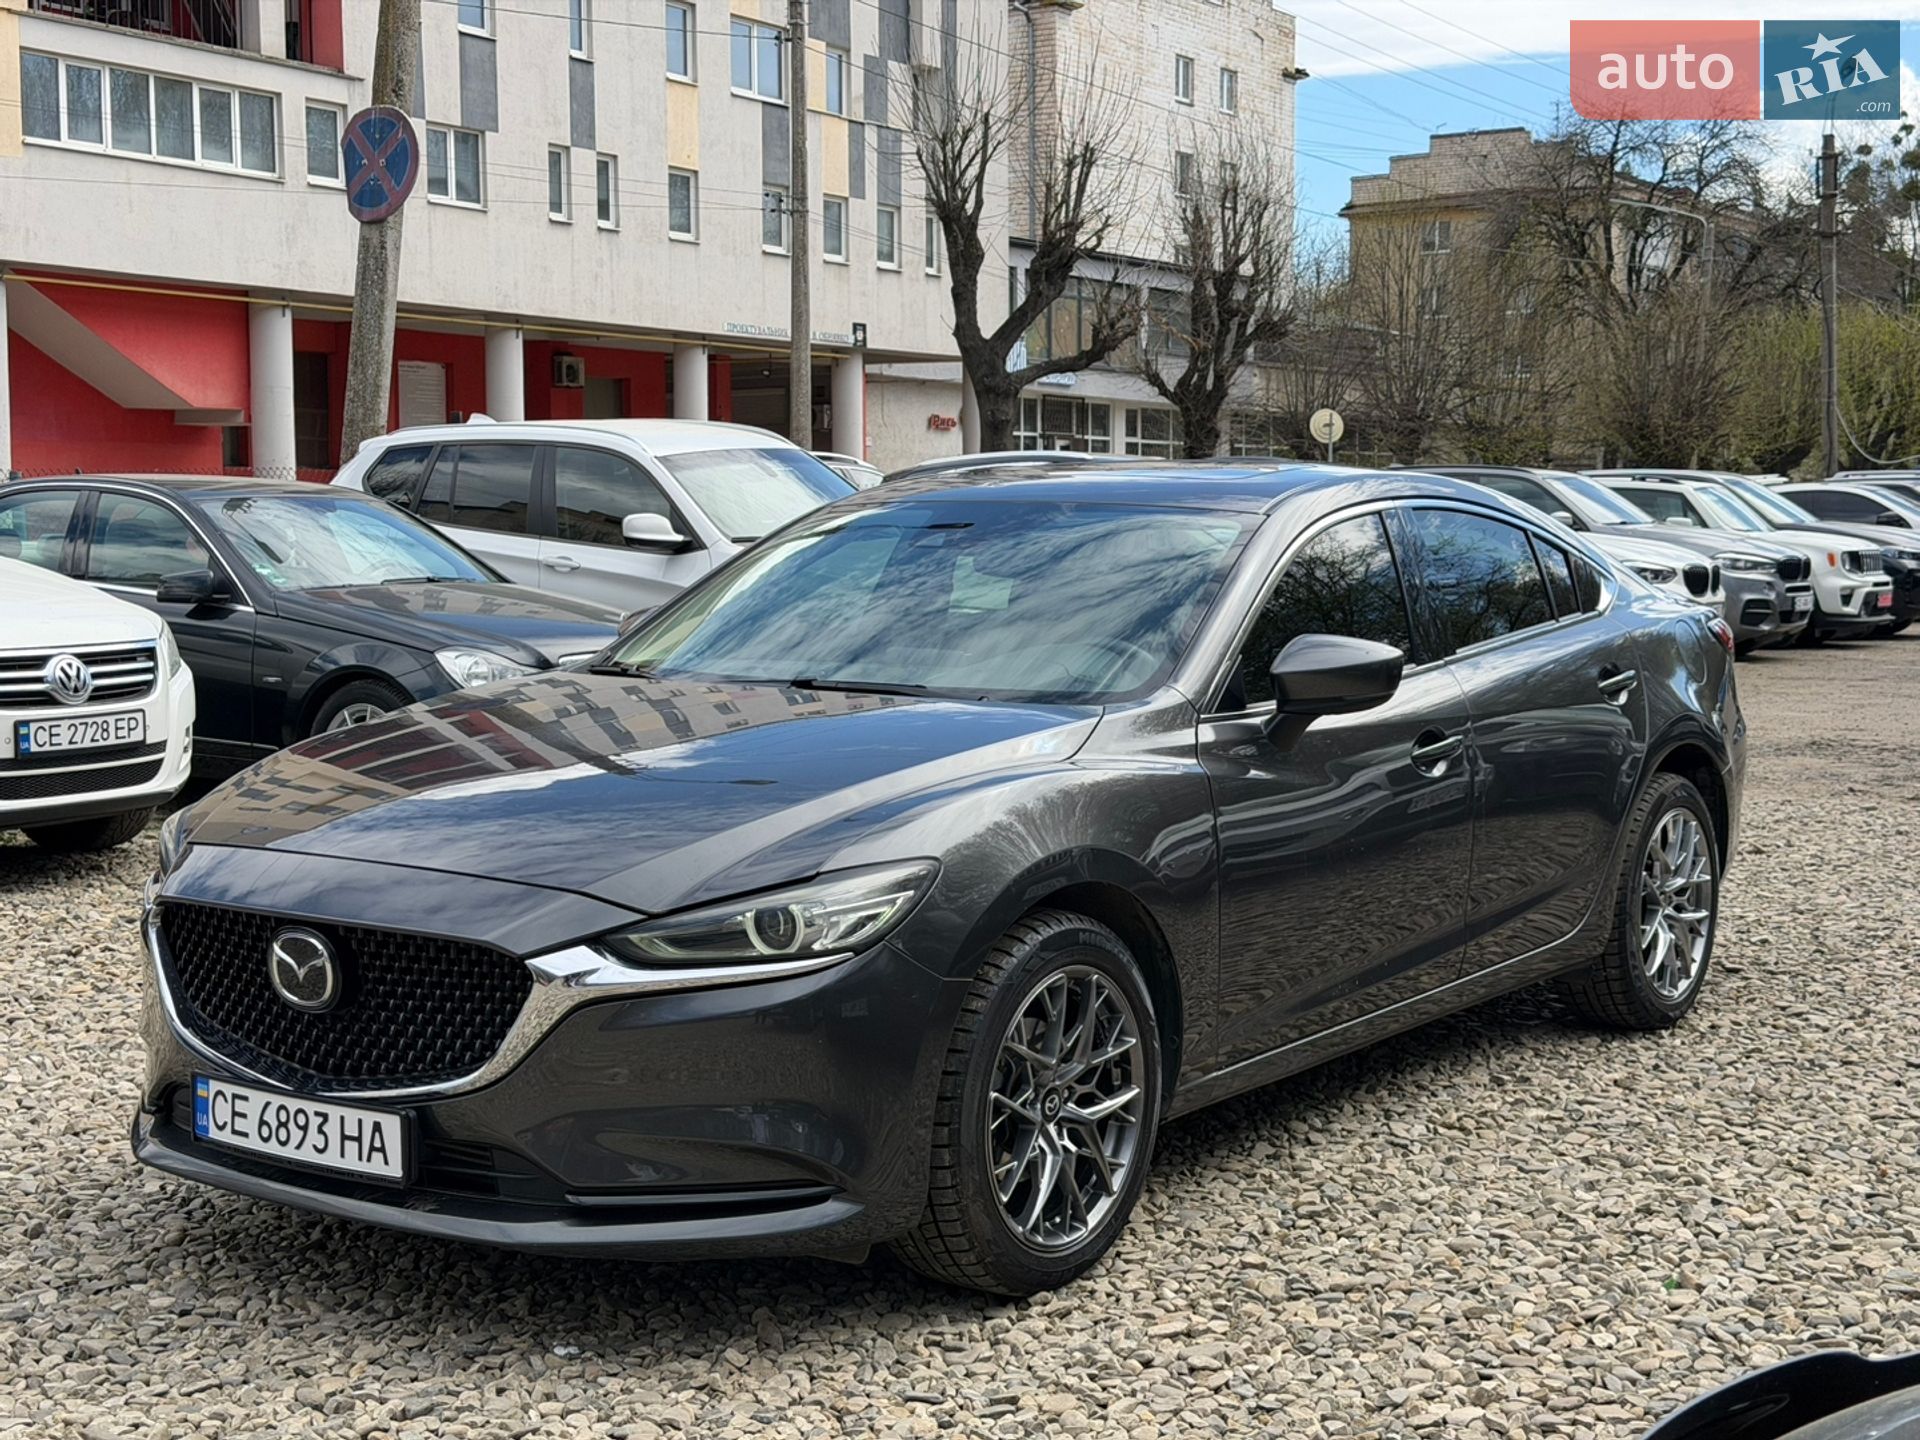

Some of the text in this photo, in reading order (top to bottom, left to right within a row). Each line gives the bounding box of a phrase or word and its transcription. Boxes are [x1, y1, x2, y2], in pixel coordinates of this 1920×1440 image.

[33, 716, 140, 748] CE 2728 EP
[197, 1112, 209, 1127] UA
[211, 1089, 390, 1167] CE 6893 HA
